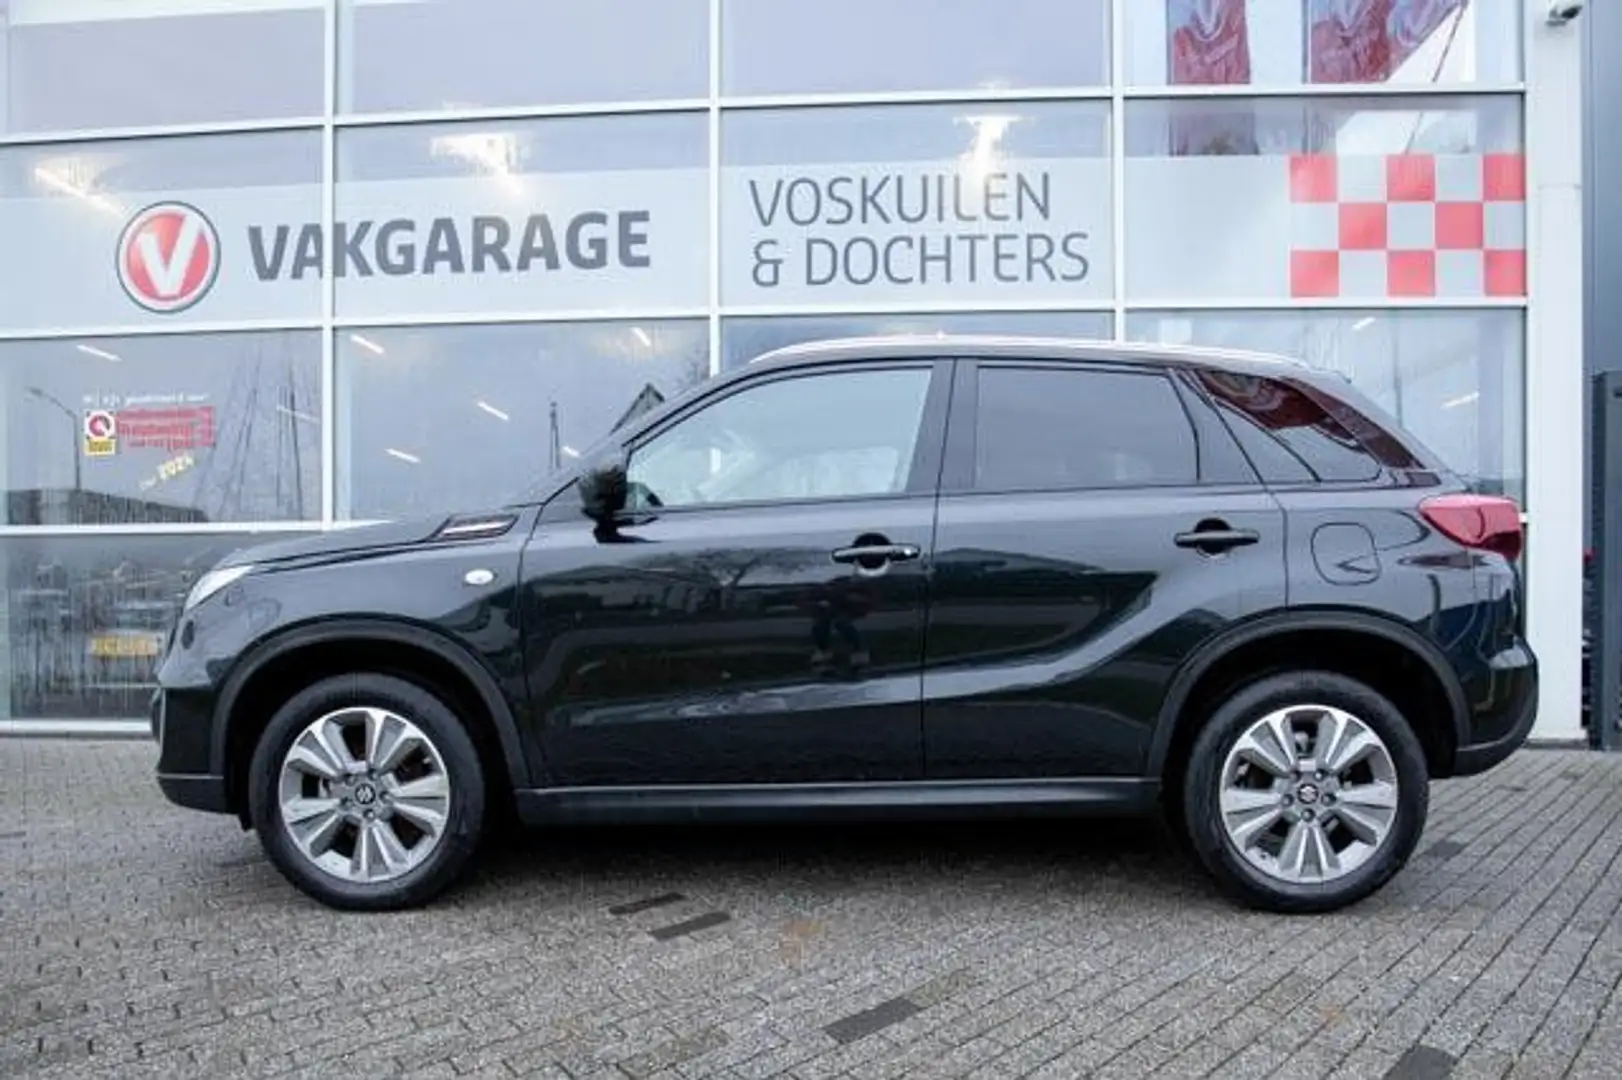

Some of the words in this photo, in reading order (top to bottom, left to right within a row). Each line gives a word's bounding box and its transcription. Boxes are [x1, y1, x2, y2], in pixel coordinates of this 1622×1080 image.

[749, 172, 1050, 227] VOSKUILEN
[247, 210, 651, 281] VAKGARAGE
[752, 239, 783, 287] &
[805, 232, 1090, 286] DOCHTERS
